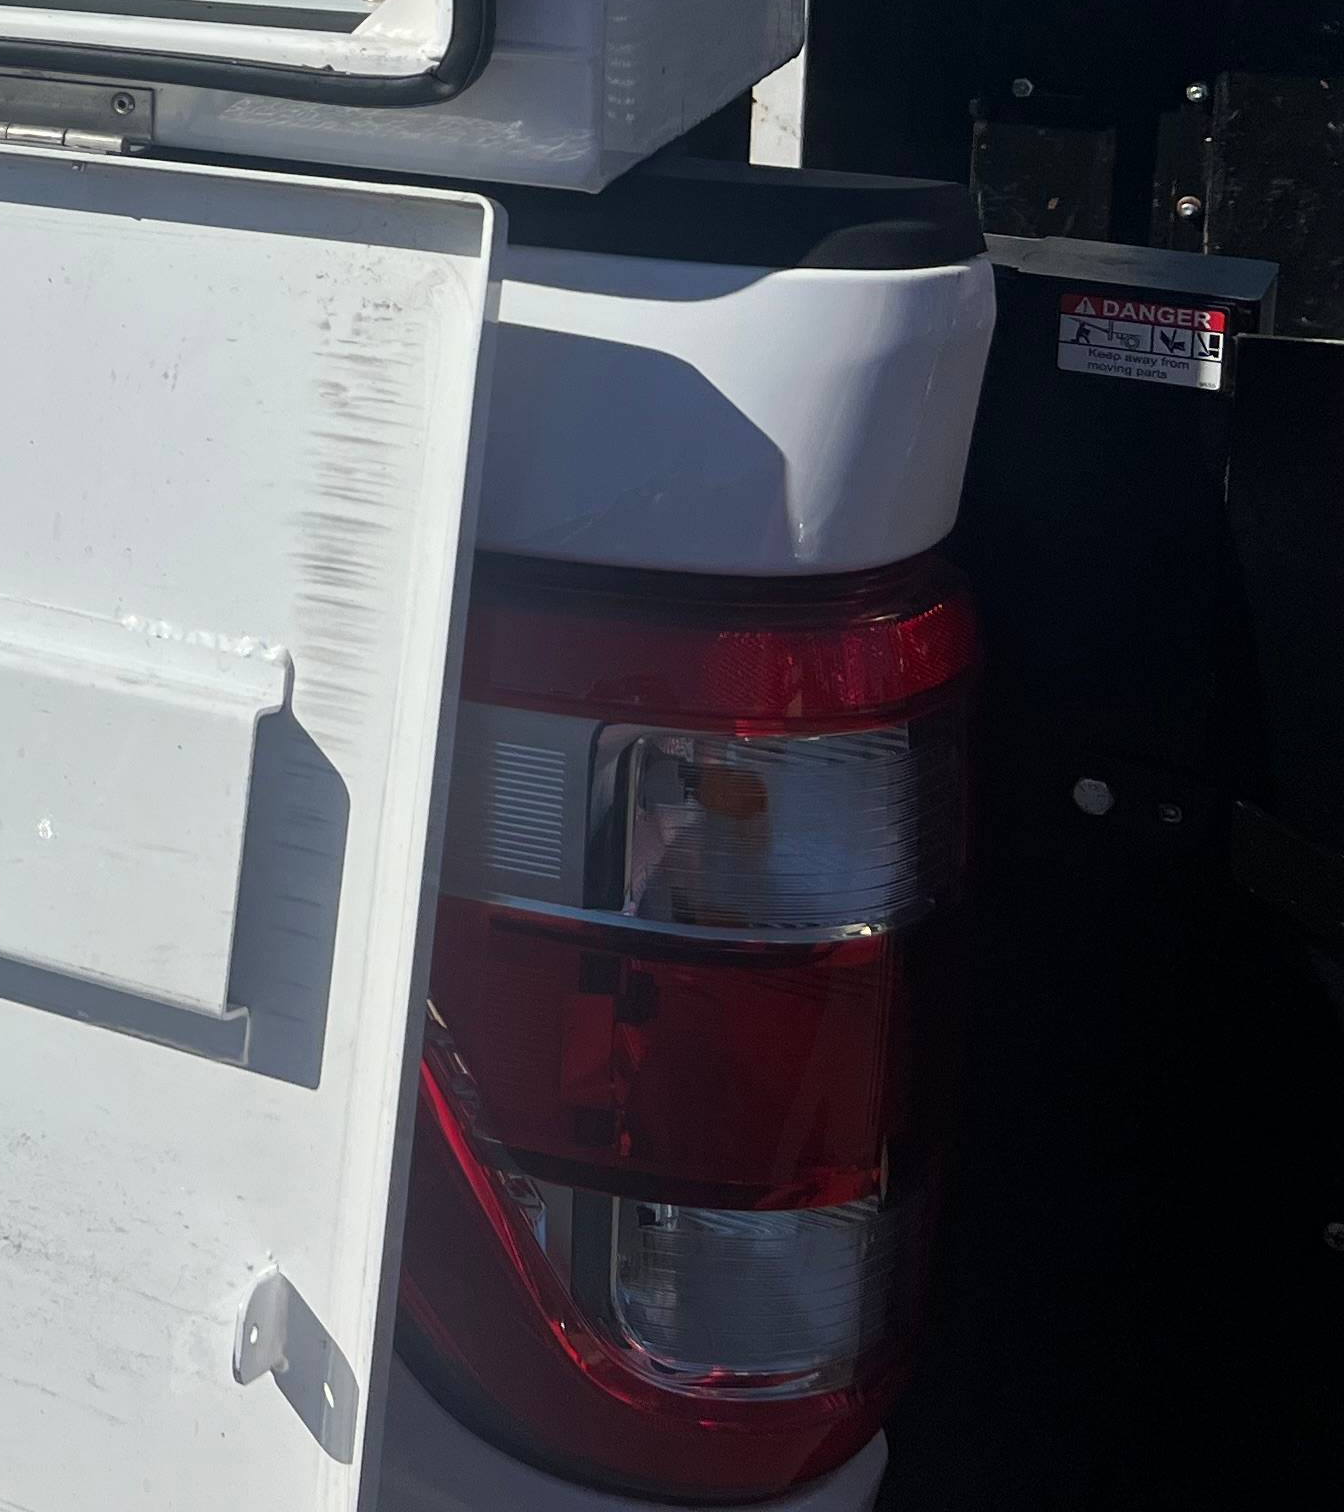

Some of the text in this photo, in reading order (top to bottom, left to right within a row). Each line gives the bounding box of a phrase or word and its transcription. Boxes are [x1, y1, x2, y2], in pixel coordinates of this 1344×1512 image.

[1103, 300, 1212, 329] DANGER
[1088, 348, 1190, 370] Keep away from
[1087, 362, 1168, 380] moving parts
